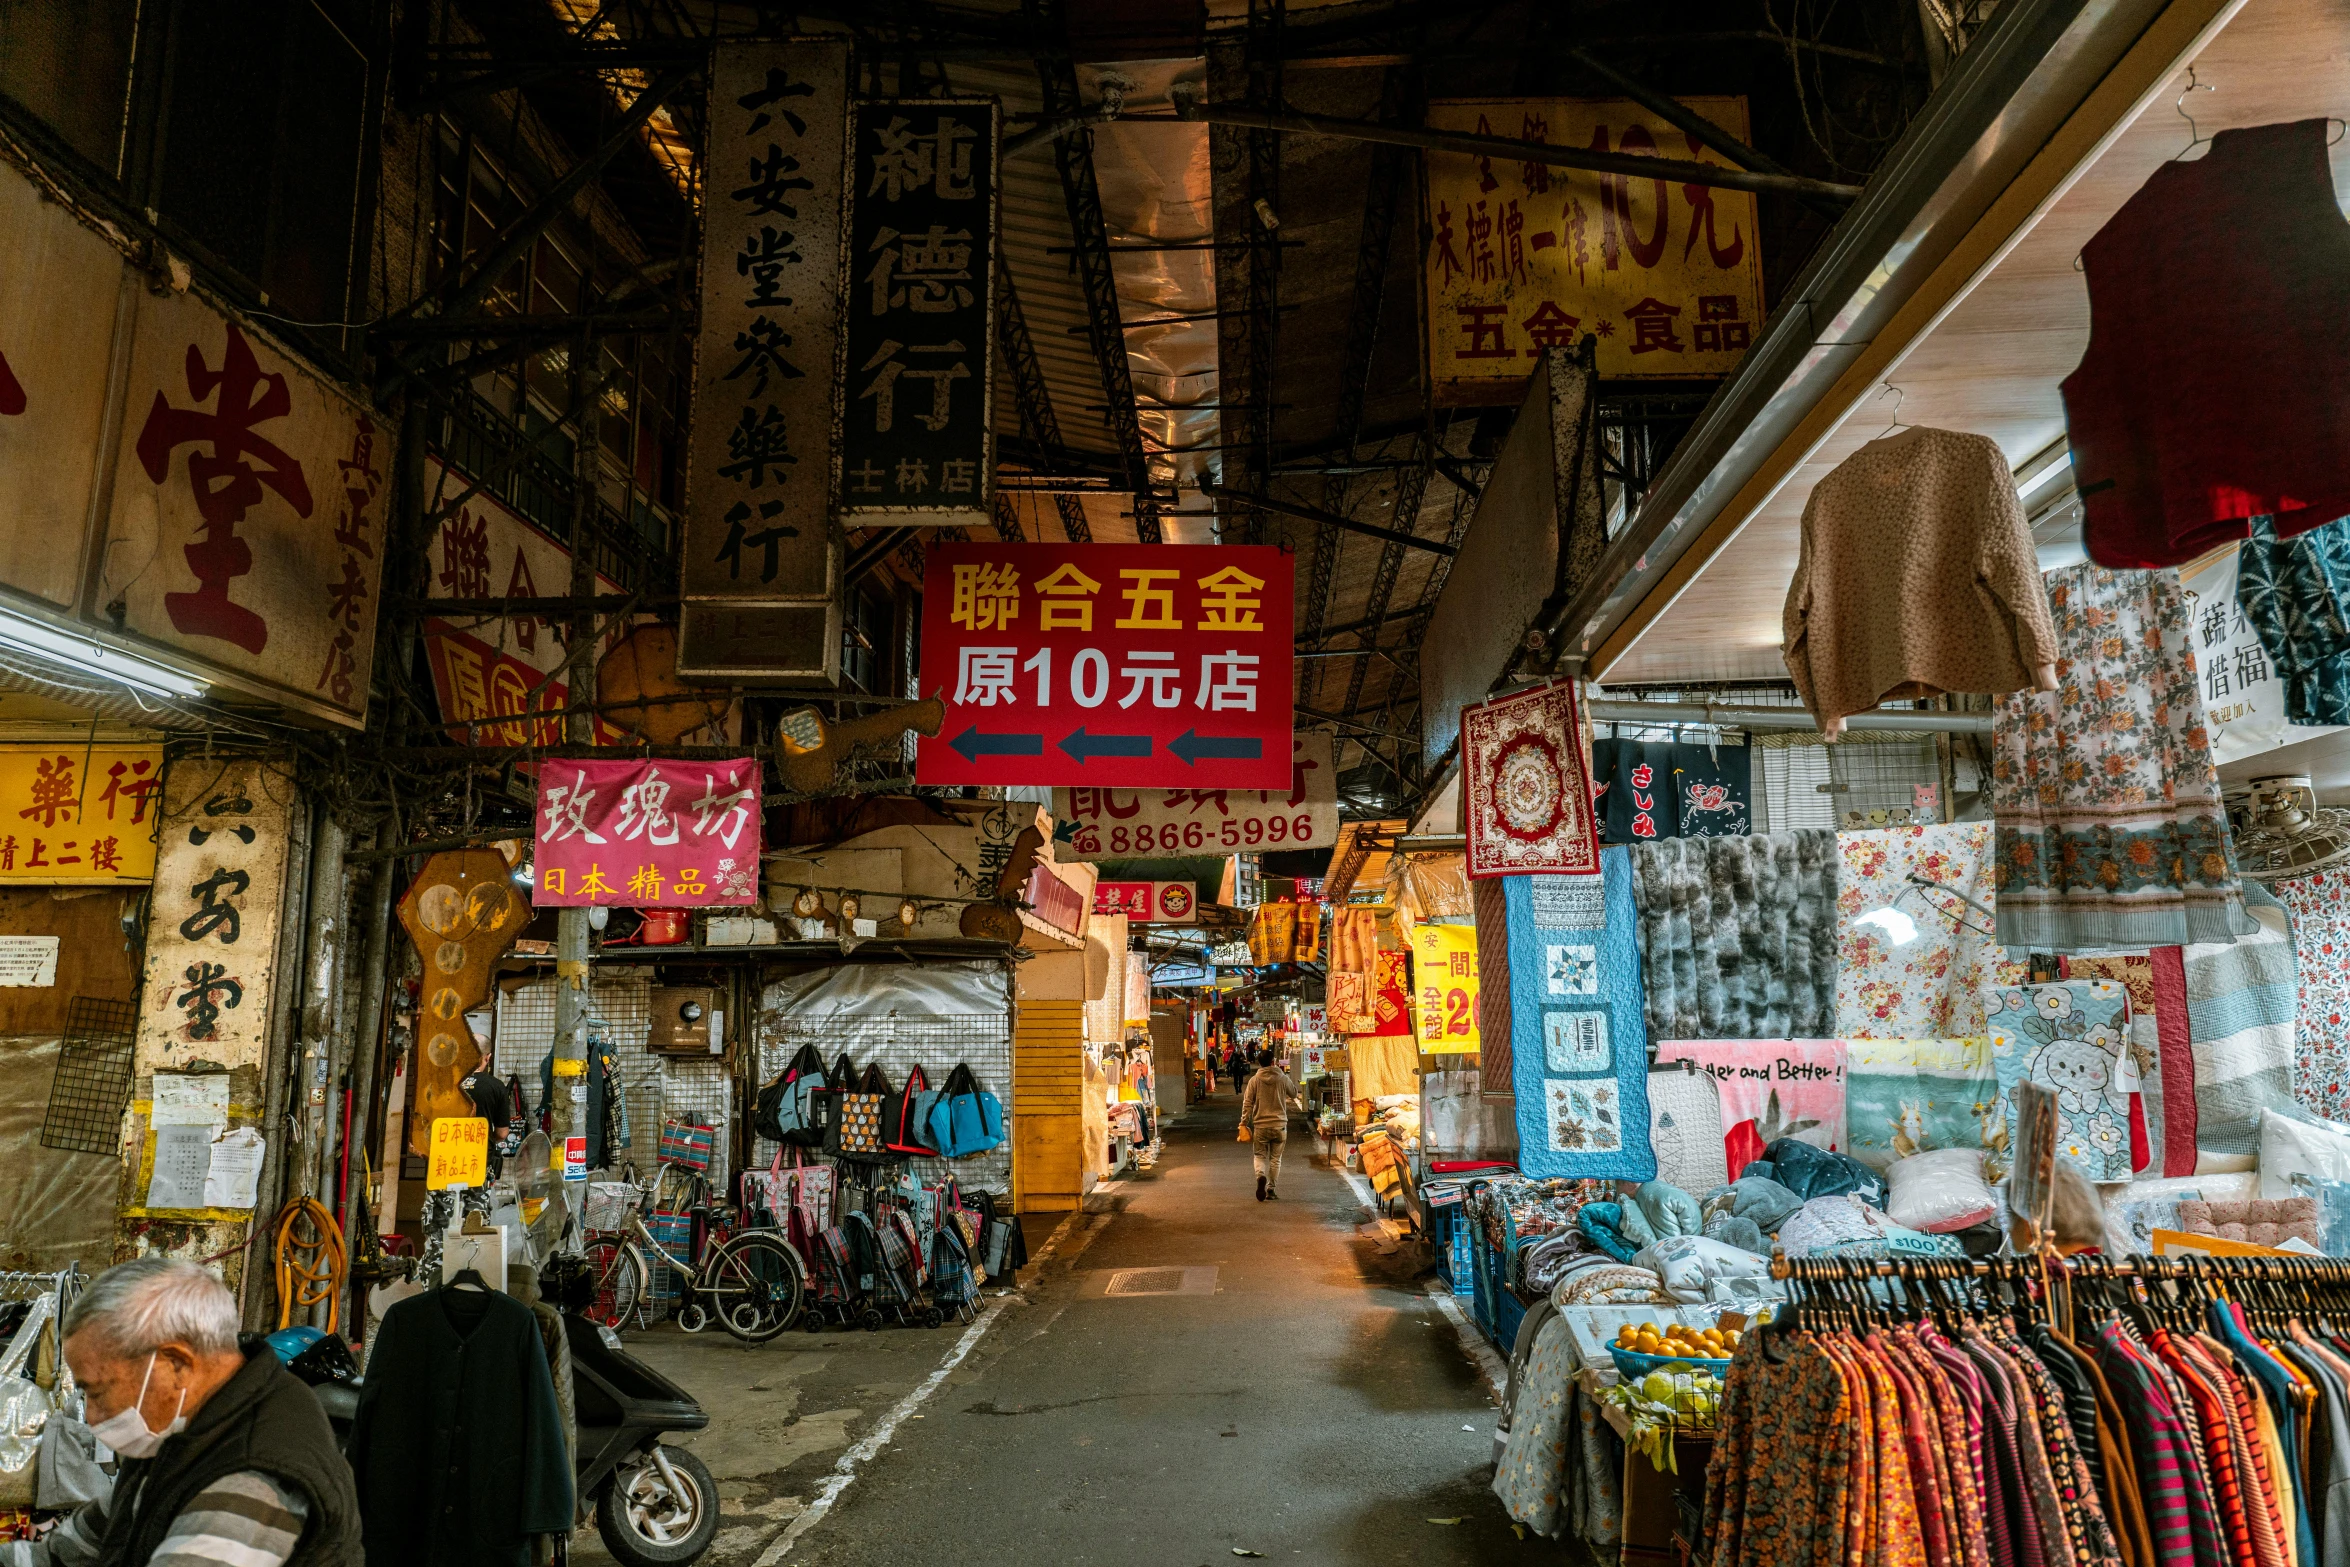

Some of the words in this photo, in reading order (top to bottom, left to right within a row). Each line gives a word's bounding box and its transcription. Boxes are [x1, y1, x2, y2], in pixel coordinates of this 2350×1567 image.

[861, 114, 979, 433] 純德行
[1623, 295, 1751, 355] 食品
[849, 457, 977, 494] 士林店
[315, 413, 383, 703] 真正老店
[950, 561, 1266, 632] 聯合五金
[952, 645, 1260, 712] 原10元店
[2205, 640, 2268, 701] 惜福
[2210, 698, 2257, 726] 歡迎加入
[19, 755, 161, 829] 藥行
[540, 767, 755, 850] 玫瑰坊
[1631, 764, 1658, 838] さしみ
[1109, 814, 1313, 854] 8866-5996
[176, 783, 257, 1040] 六安堂
[543, 864, 707, 900] 日本精品
[1423, 932, 1439, 948] 安
[1423, 986, 1443, 1040] 全館
[1739, 1064, 1771, 1082] and
[1894, 1237, 1936, 1252] $100
